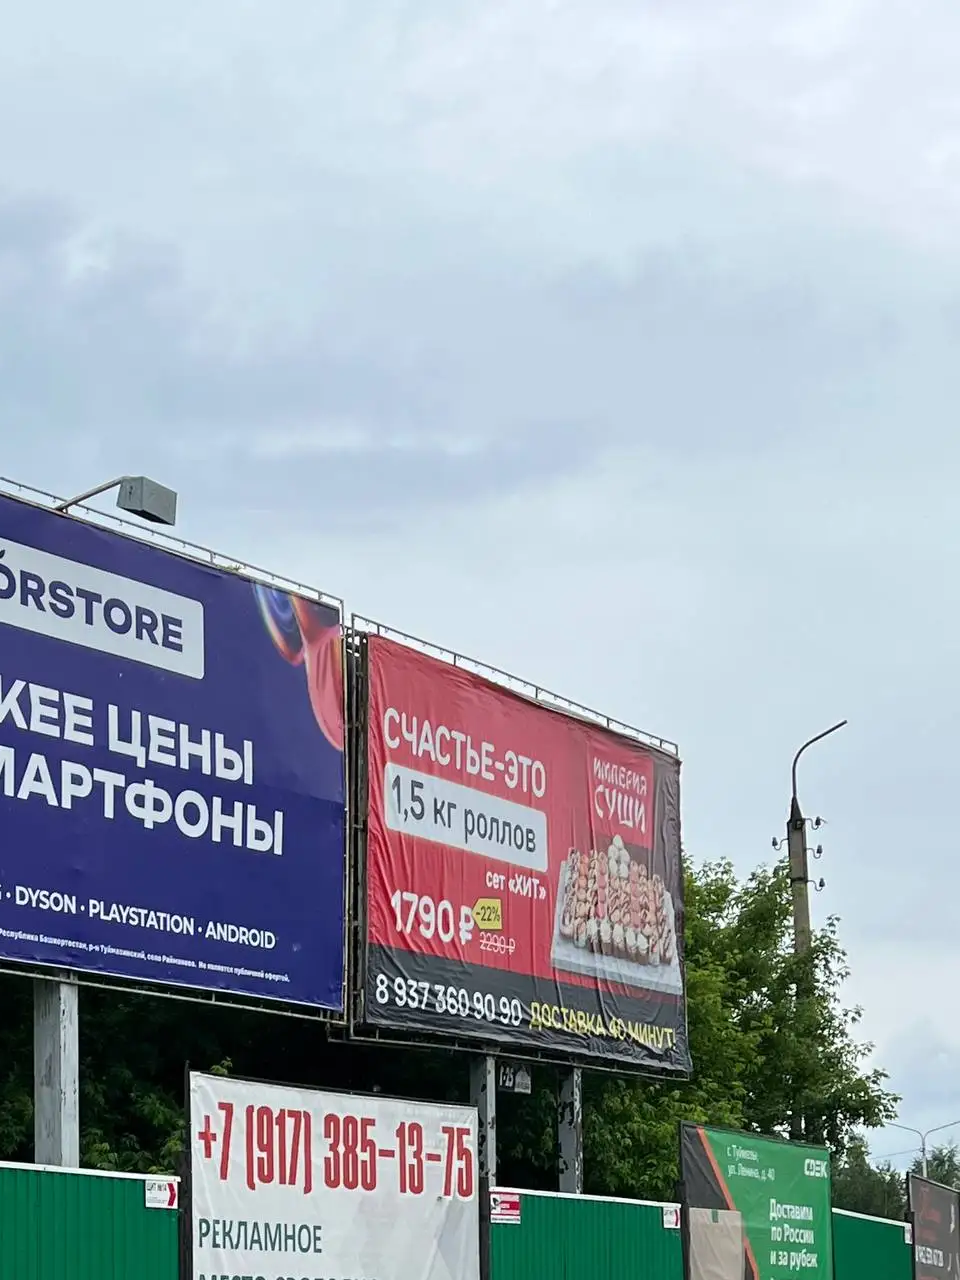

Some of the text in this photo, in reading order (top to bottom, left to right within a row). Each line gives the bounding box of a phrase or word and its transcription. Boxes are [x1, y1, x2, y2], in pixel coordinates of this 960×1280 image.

[108, 702, 253, 784] ЦЕНЫ
[384, 708, 546, 798] СЧАСТЬЕ-ЭТО
[594, 756, 647, 796] ИМПЕРИЯ
[392, 775, 536, 852] 1,5 кг роллов
[595, 784, 646, 834] СУШИ
[486, 871, 547, 899] сет «ХИТ»
[15, 885, 77, 914] DYSON
[88, 899, 194, 936] PLAYSTATION
[205, 920, 276, 949] ANDROID
[391, 889, 454, 943] 1790
[476, 906, 501, 922] -22%
[375, 974, 389, 1004] 8
[393, 977, 430, 1010] 937
[529, 1001, 607, 1037] ДОСТАВКА
[198, 1101, 473, 1198] +7 (917) 385-13-75
[769, 1198, 813, 1221] Доставим
[198, 1218, 323, 1253] РЕКЛАМНОЕ
[771, 1223, 814, 1244] по России
[770, 1248, 818, 1271] и за рубеж
